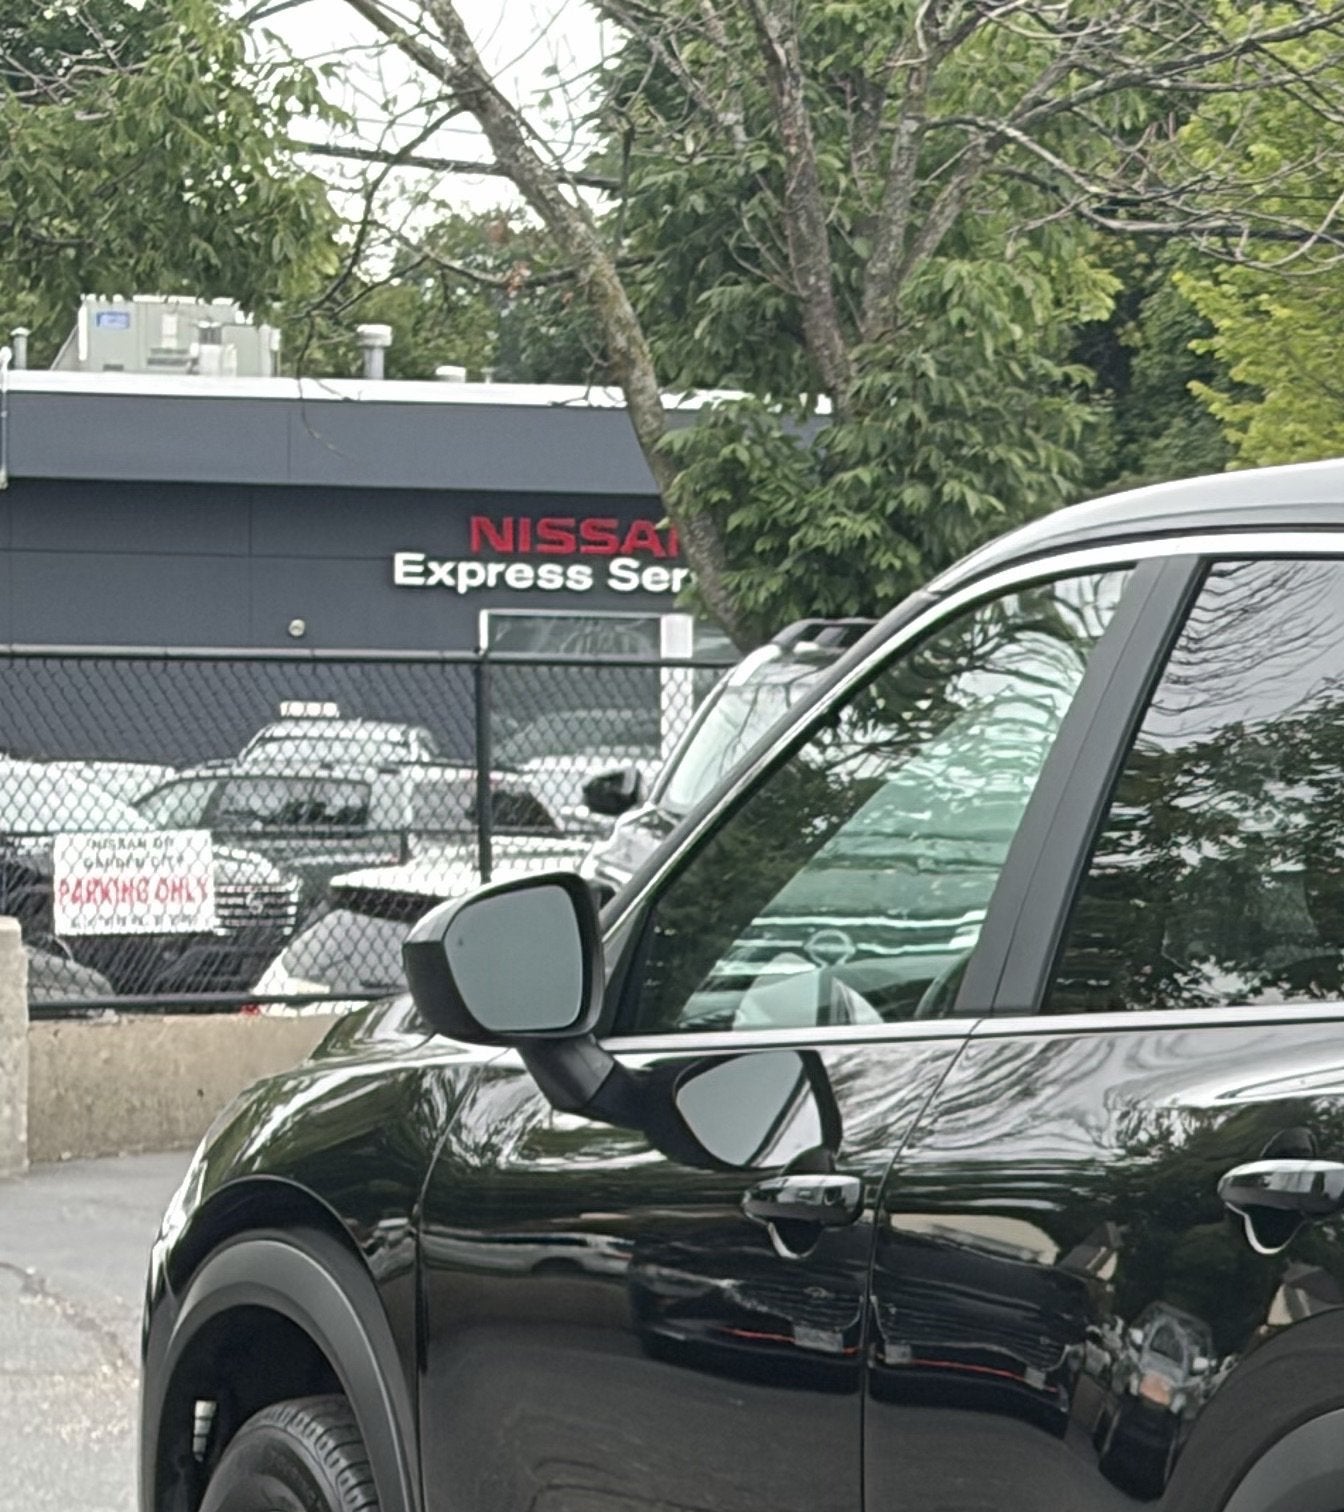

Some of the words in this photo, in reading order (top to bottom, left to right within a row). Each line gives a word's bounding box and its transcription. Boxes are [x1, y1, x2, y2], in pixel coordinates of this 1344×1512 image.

[393, 551, 594, 595] Express
[606, 556, 692, 593] Ser
[59, 875, 150, 903] PARKING
[156, 876, 209, 903] ONLY
